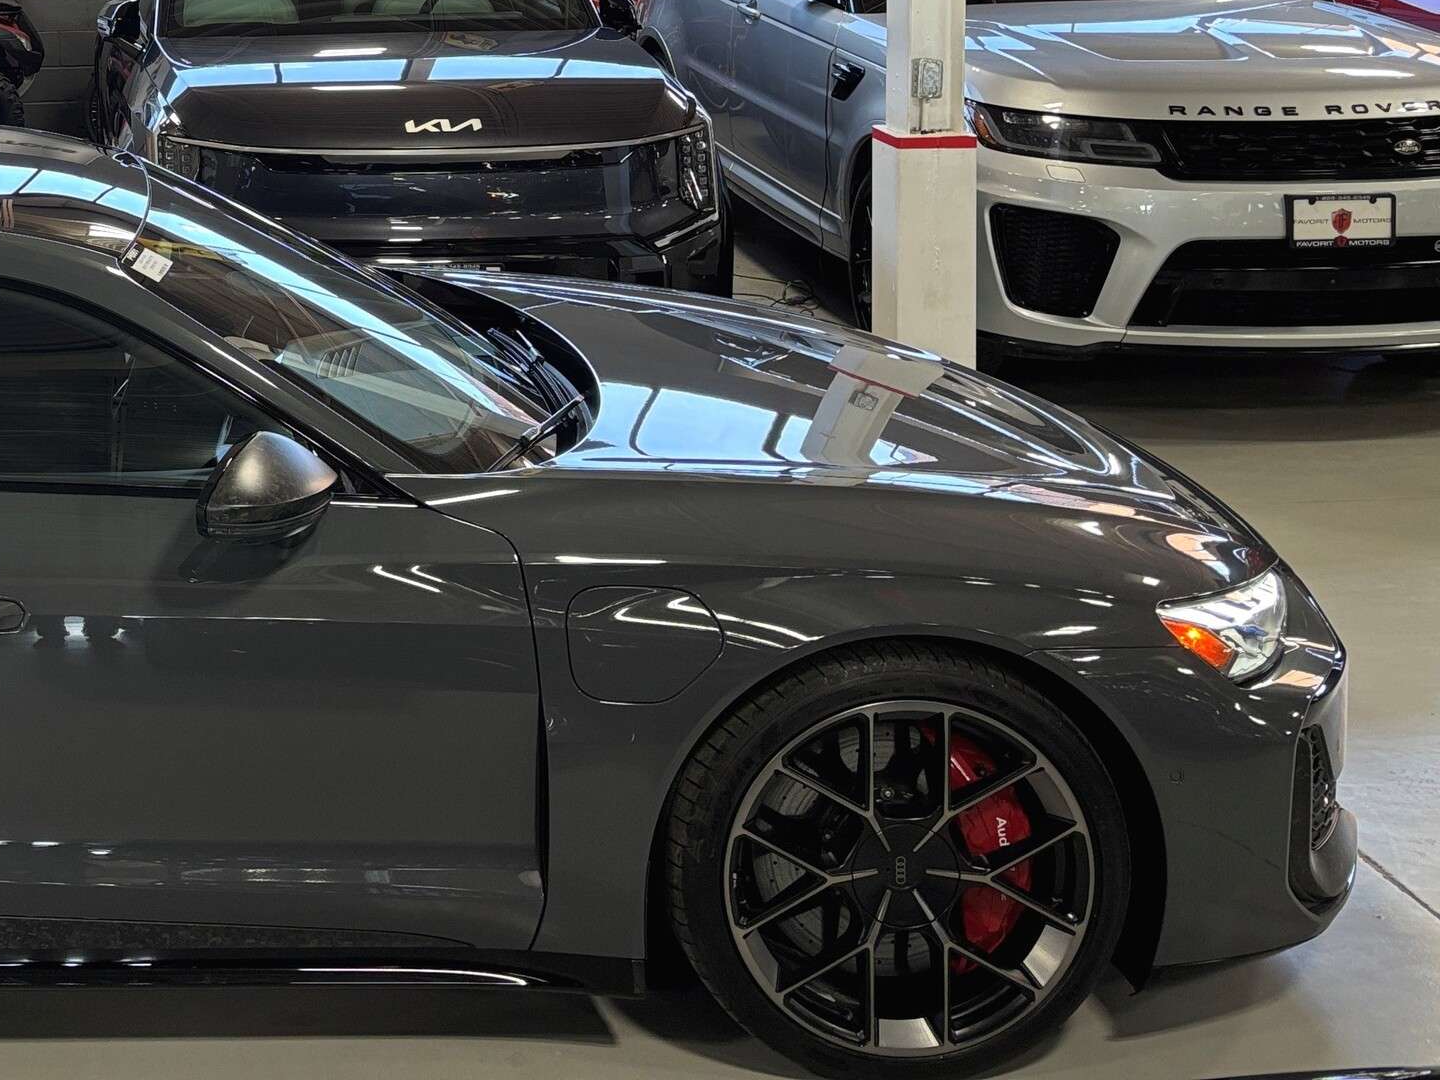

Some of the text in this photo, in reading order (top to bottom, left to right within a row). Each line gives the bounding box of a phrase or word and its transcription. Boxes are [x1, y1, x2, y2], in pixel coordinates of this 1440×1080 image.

[1168, 105, 1300, 117] RANGE
[405, 118, 483, 133] KIA
[1296, 239, 1390, 248] FAVORIT MOTORS
[996, 817, 1010, 847] Aud
